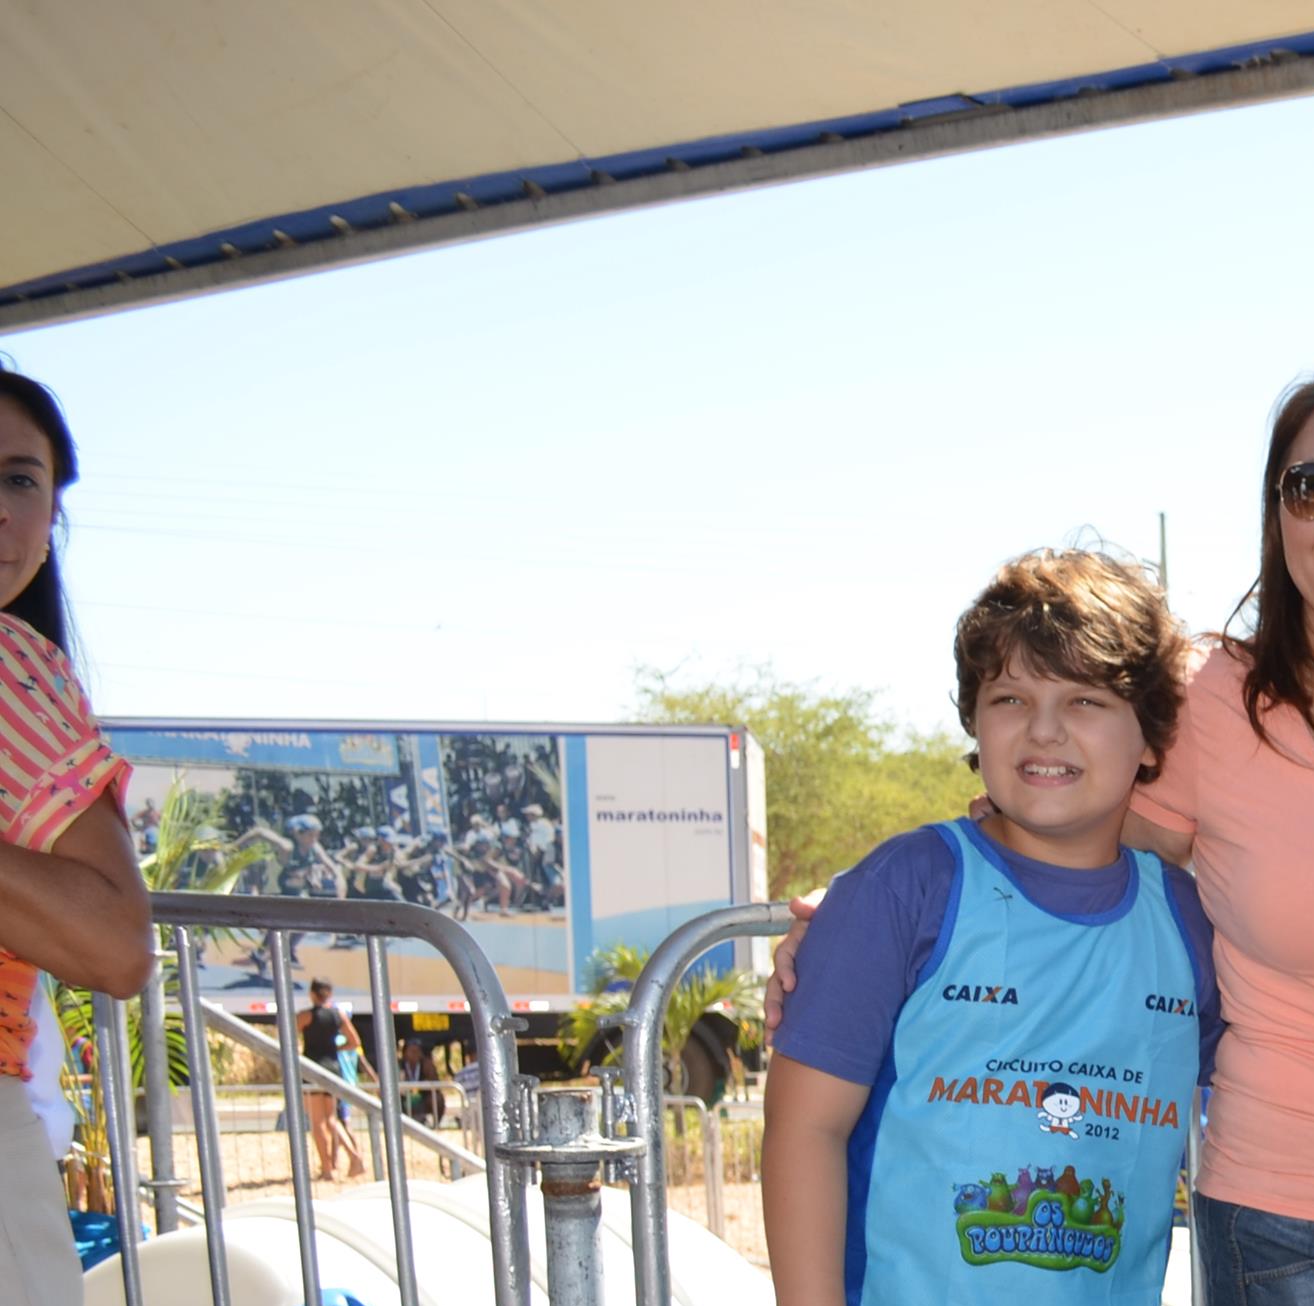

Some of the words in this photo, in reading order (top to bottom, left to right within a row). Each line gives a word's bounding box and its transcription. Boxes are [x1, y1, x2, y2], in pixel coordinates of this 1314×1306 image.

[596, 808, 723, 823] maratoninha
[942, 984, 1019, 1005] CAIXA
[1068, 1062, 1117, 1081] CAIXA
[1123, 1069, 1144, 1084] DE
[1085, 1123, 1120, 1140] 2012
[1033, 1201, 1065, 1226] OS
